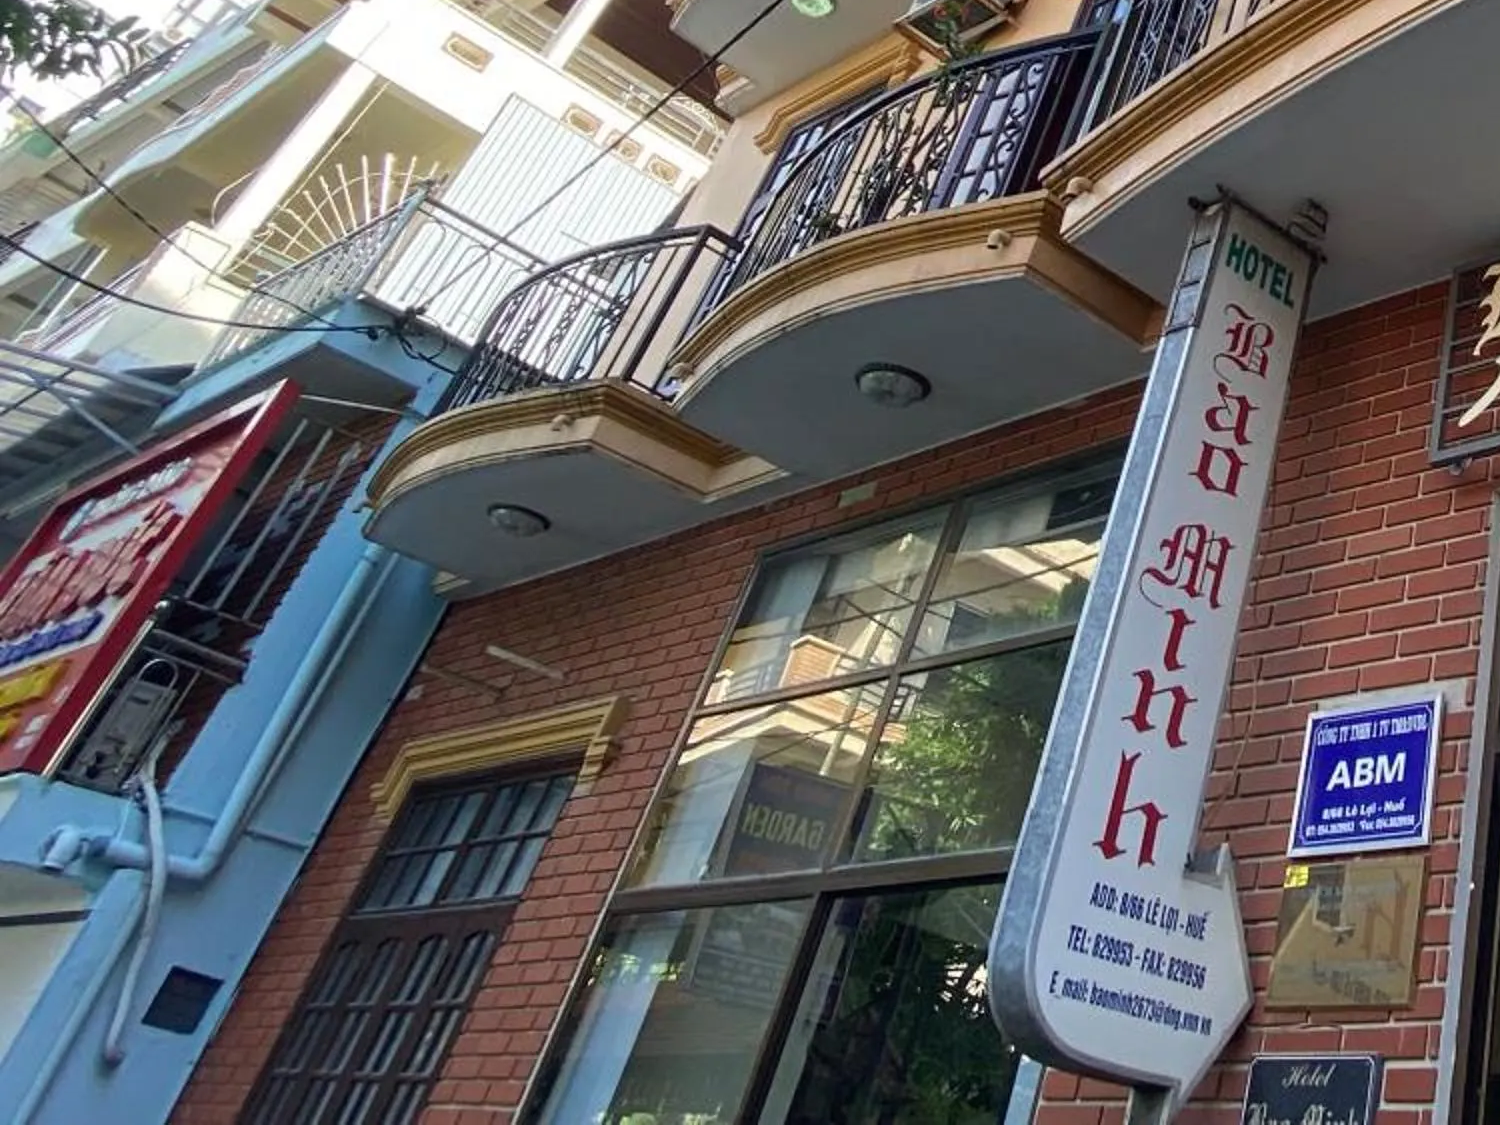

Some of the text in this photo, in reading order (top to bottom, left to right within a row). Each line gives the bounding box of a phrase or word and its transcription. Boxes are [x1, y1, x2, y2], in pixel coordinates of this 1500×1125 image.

[1224, 234, 1296, 309] HOTEL
[1325, 752, 1407, 792] ABM
[1066, 925, 1091, 956] TEL:
[1281, 1064, 1337, 1088] Hotel
